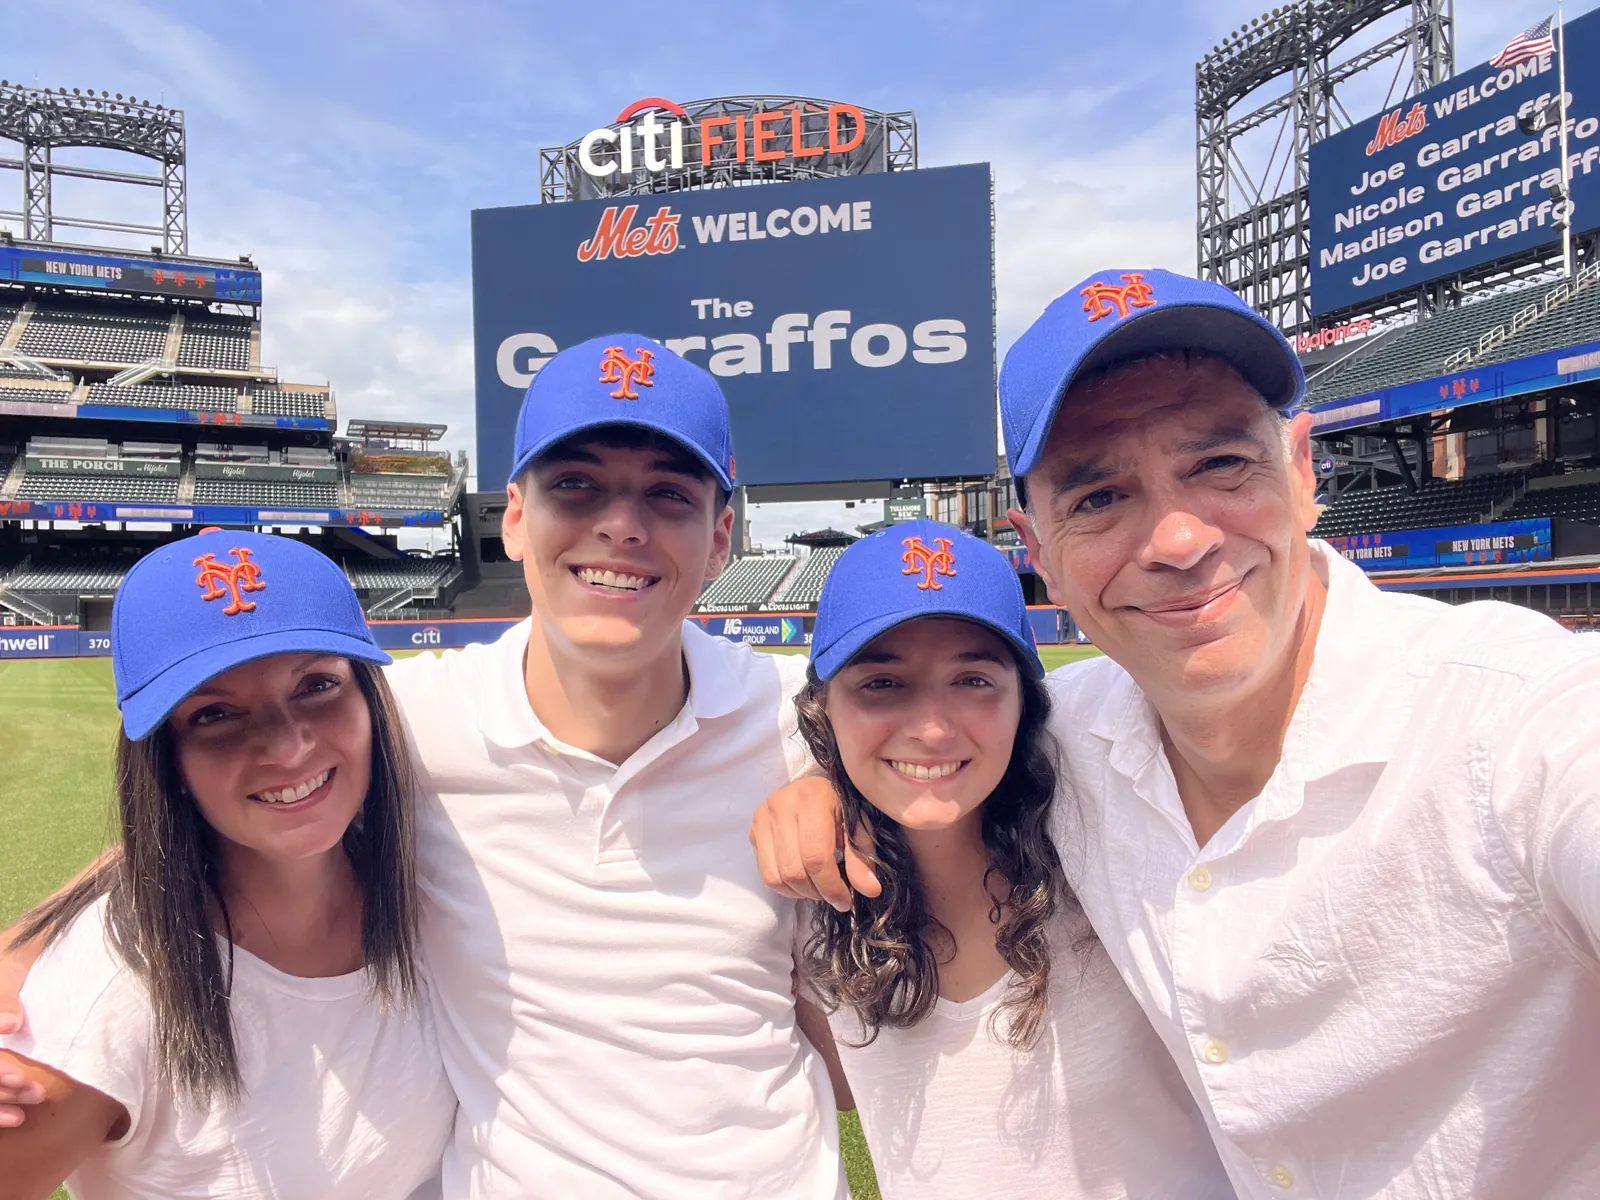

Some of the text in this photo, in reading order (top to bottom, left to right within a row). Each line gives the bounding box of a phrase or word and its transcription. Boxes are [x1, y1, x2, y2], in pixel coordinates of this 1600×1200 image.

[1366, 55, 1553, 157] Mets WELCOME
[578, 104, 865, 177] citi FIELD
[1334, 115, 1599, 233] Nicole Garraffo
[1351, 160, 1406, 196] Joe
[1320, 146, 1600, 269] Madison Garraff
[577, 200, 872, 263] Mets WELCOME
[1352, 199, 1576, 287] Joe Garraffo
[45, 260, 122, 280] NEW YORK METS
[690, 298, 755, 320] The
[1297, 318, 1371, 352] balance
[495, 309, 969, 390] Graffos
[39, 459, 69, 469] THE
[73, 460, 124, 471] PORCH
[1355, 547, 1373, 559] YORK
[1373, 546, 1393, 558] METS
[1452, 536, 1515, 553] NEW YORK METS
[789, 603, 810, 611] LIGHT
[411, 629, 441, 645] citi
[742, 626, 780, 635] HAUGLAND
[743, 635, 766, 644] GROUP
[88, 638, 110, 649] 370
